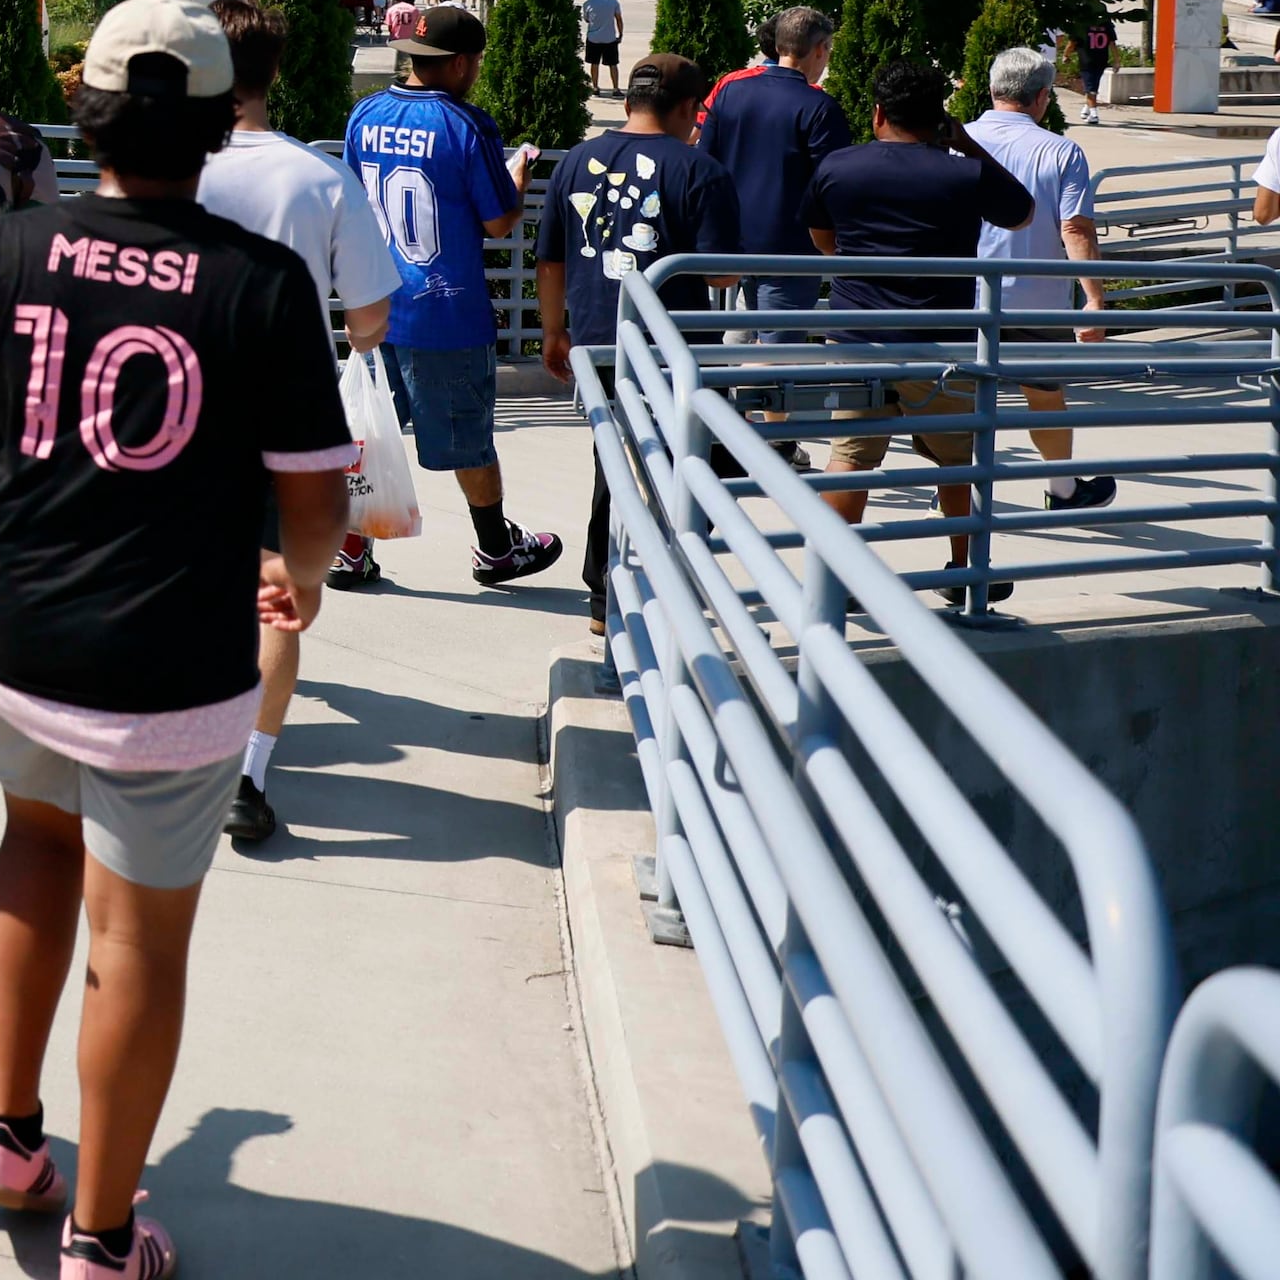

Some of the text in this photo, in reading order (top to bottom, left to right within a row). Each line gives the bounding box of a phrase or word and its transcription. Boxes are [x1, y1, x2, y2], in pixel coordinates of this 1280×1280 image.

[1087, 32, 1108, 49] 10
[361, 124, 436, 159] MESSI
[360, 161, 442, 267] 10
[47, 232, 200, 295] MESSI
[14, 304, 204, 473] 10
